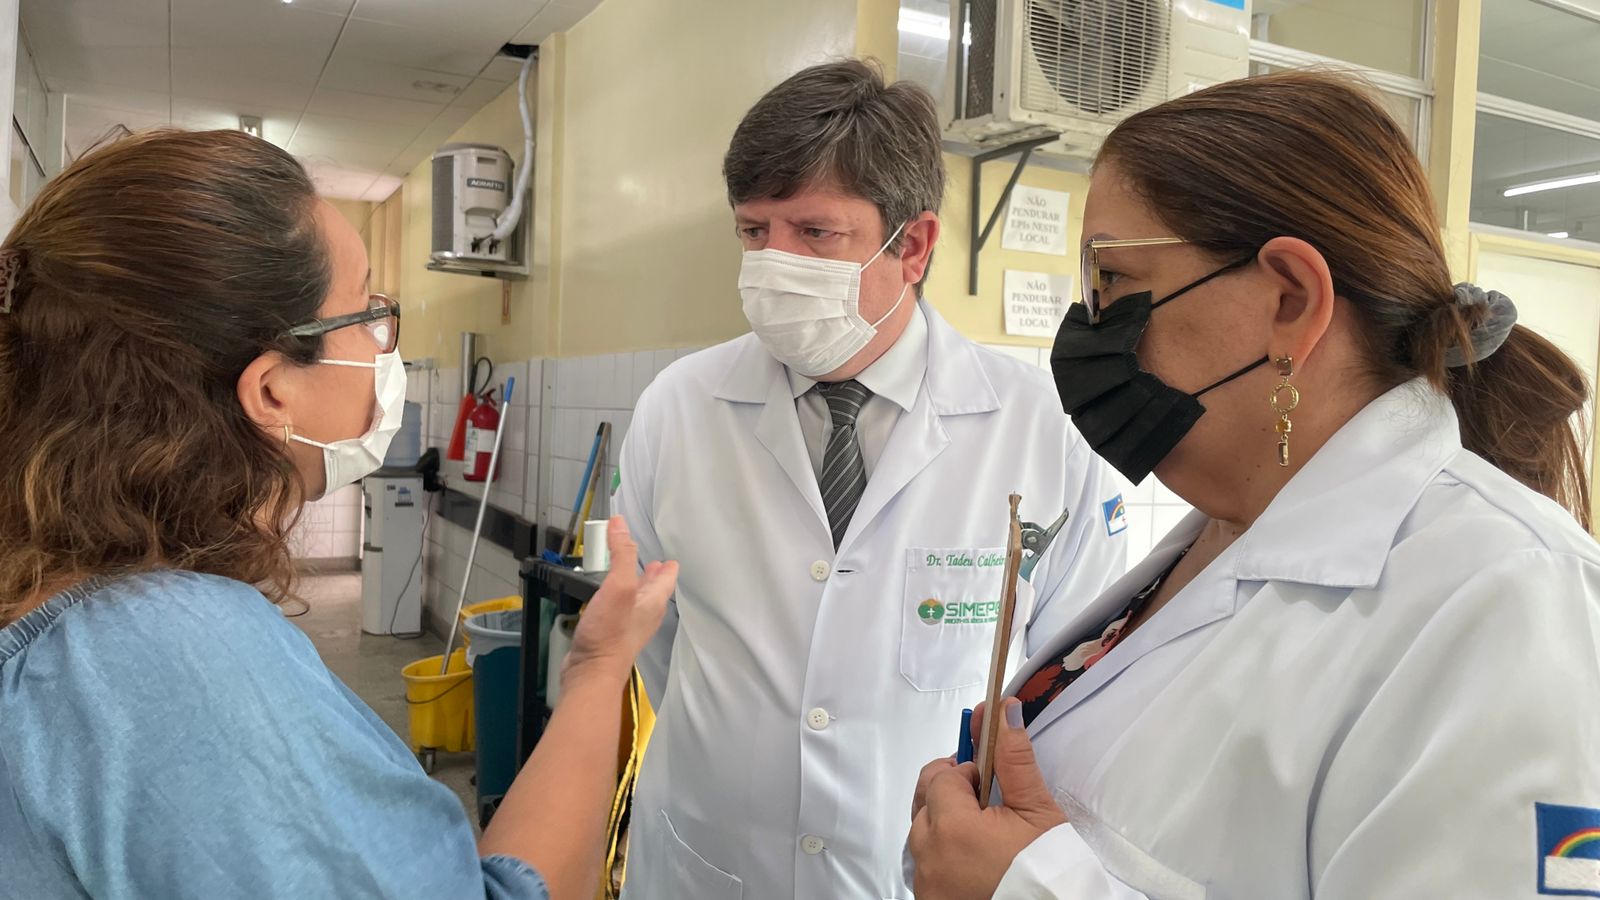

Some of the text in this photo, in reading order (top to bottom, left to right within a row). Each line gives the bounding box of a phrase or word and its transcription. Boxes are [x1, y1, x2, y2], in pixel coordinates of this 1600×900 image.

[1026, 195, 1047, 207] NÃO
[1012, 206, 1060, 222] PENDURAR
[1032, 222, 1059, 234] NESTE
[1019, 233, 1050, 245] LOCAL
[1026, 279, 1047, 291] NÃO
[1012, 292, 1062, 305] PENDURAR
[1031, 306, 1061, 317] NESTE
[1019, 318, 1050, 329] LOCAL
[926, 553, 1005, 568] Dr. Tadeu Calheir
